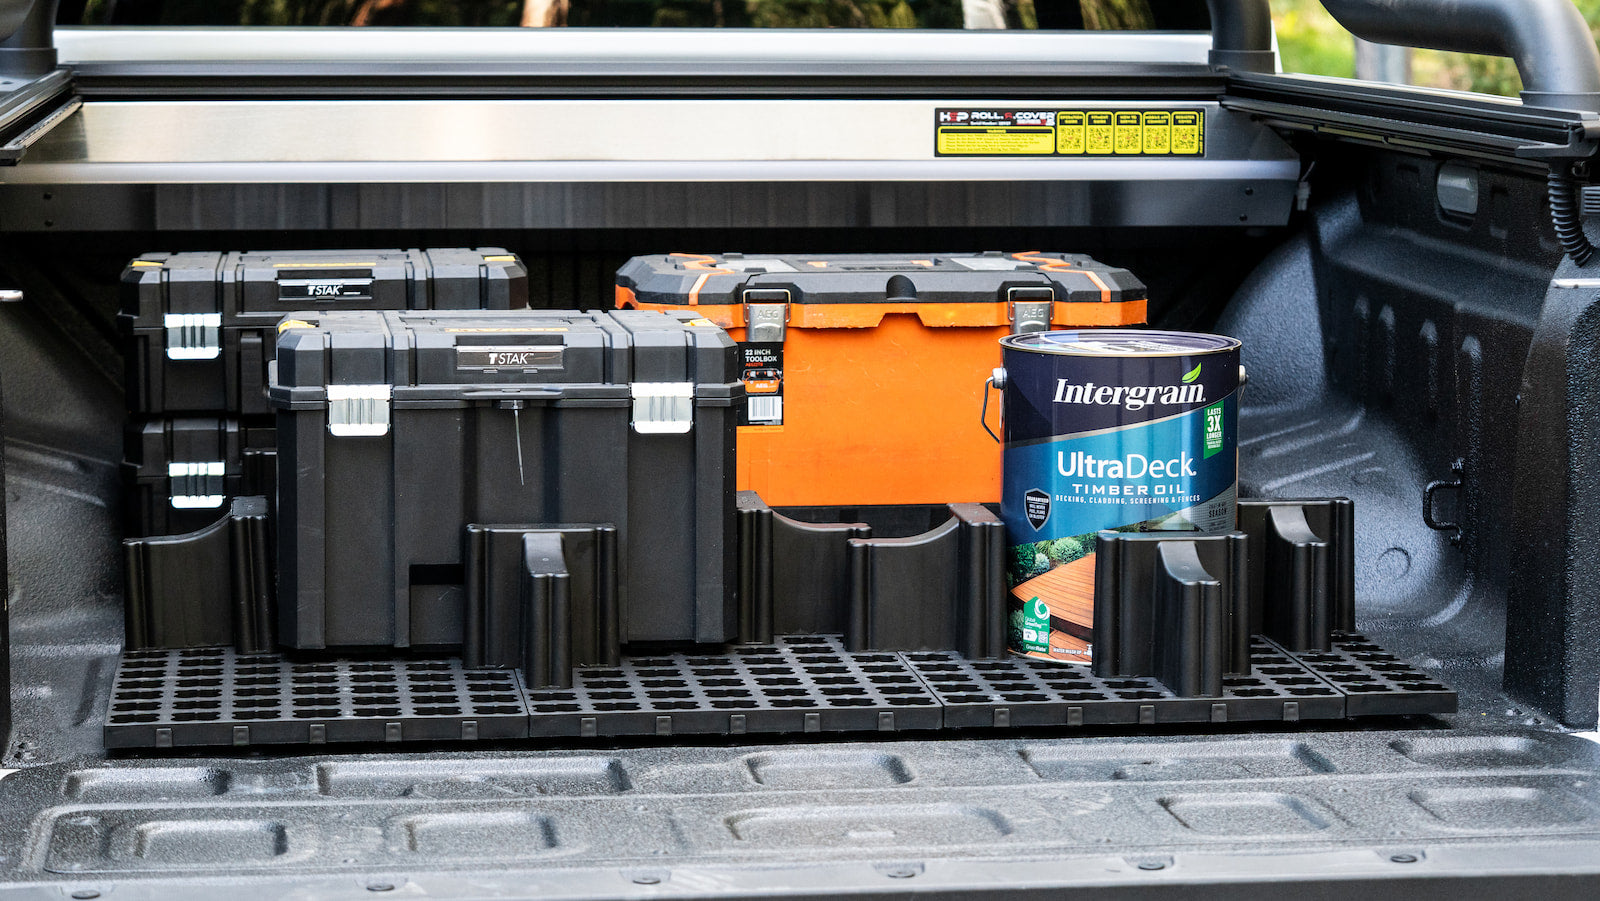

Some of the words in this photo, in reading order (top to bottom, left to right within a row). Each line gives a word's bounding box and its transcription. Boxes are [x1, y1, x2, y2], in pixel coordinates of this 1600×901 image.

[1022, 308, 1044, 318] AEG
[1052, 378, 1204, 411] Intergrain
[1207, 408, 1222, 416] LASTS
[1207, 415, 1222, 432] 3X
[1057, 450, 1196, 478] UltraDeck
[1072, 484, 1148, 496] TIMBER
[1154, 484, 1185, 494] OIL
[1056, 494, 1086, 504] DECKING,
[1089, 496, 1128, 504] CLADDING,
[1130, 496, 1170, 504] SCREENING
[1178, 494, 1200, 502] FENCES
